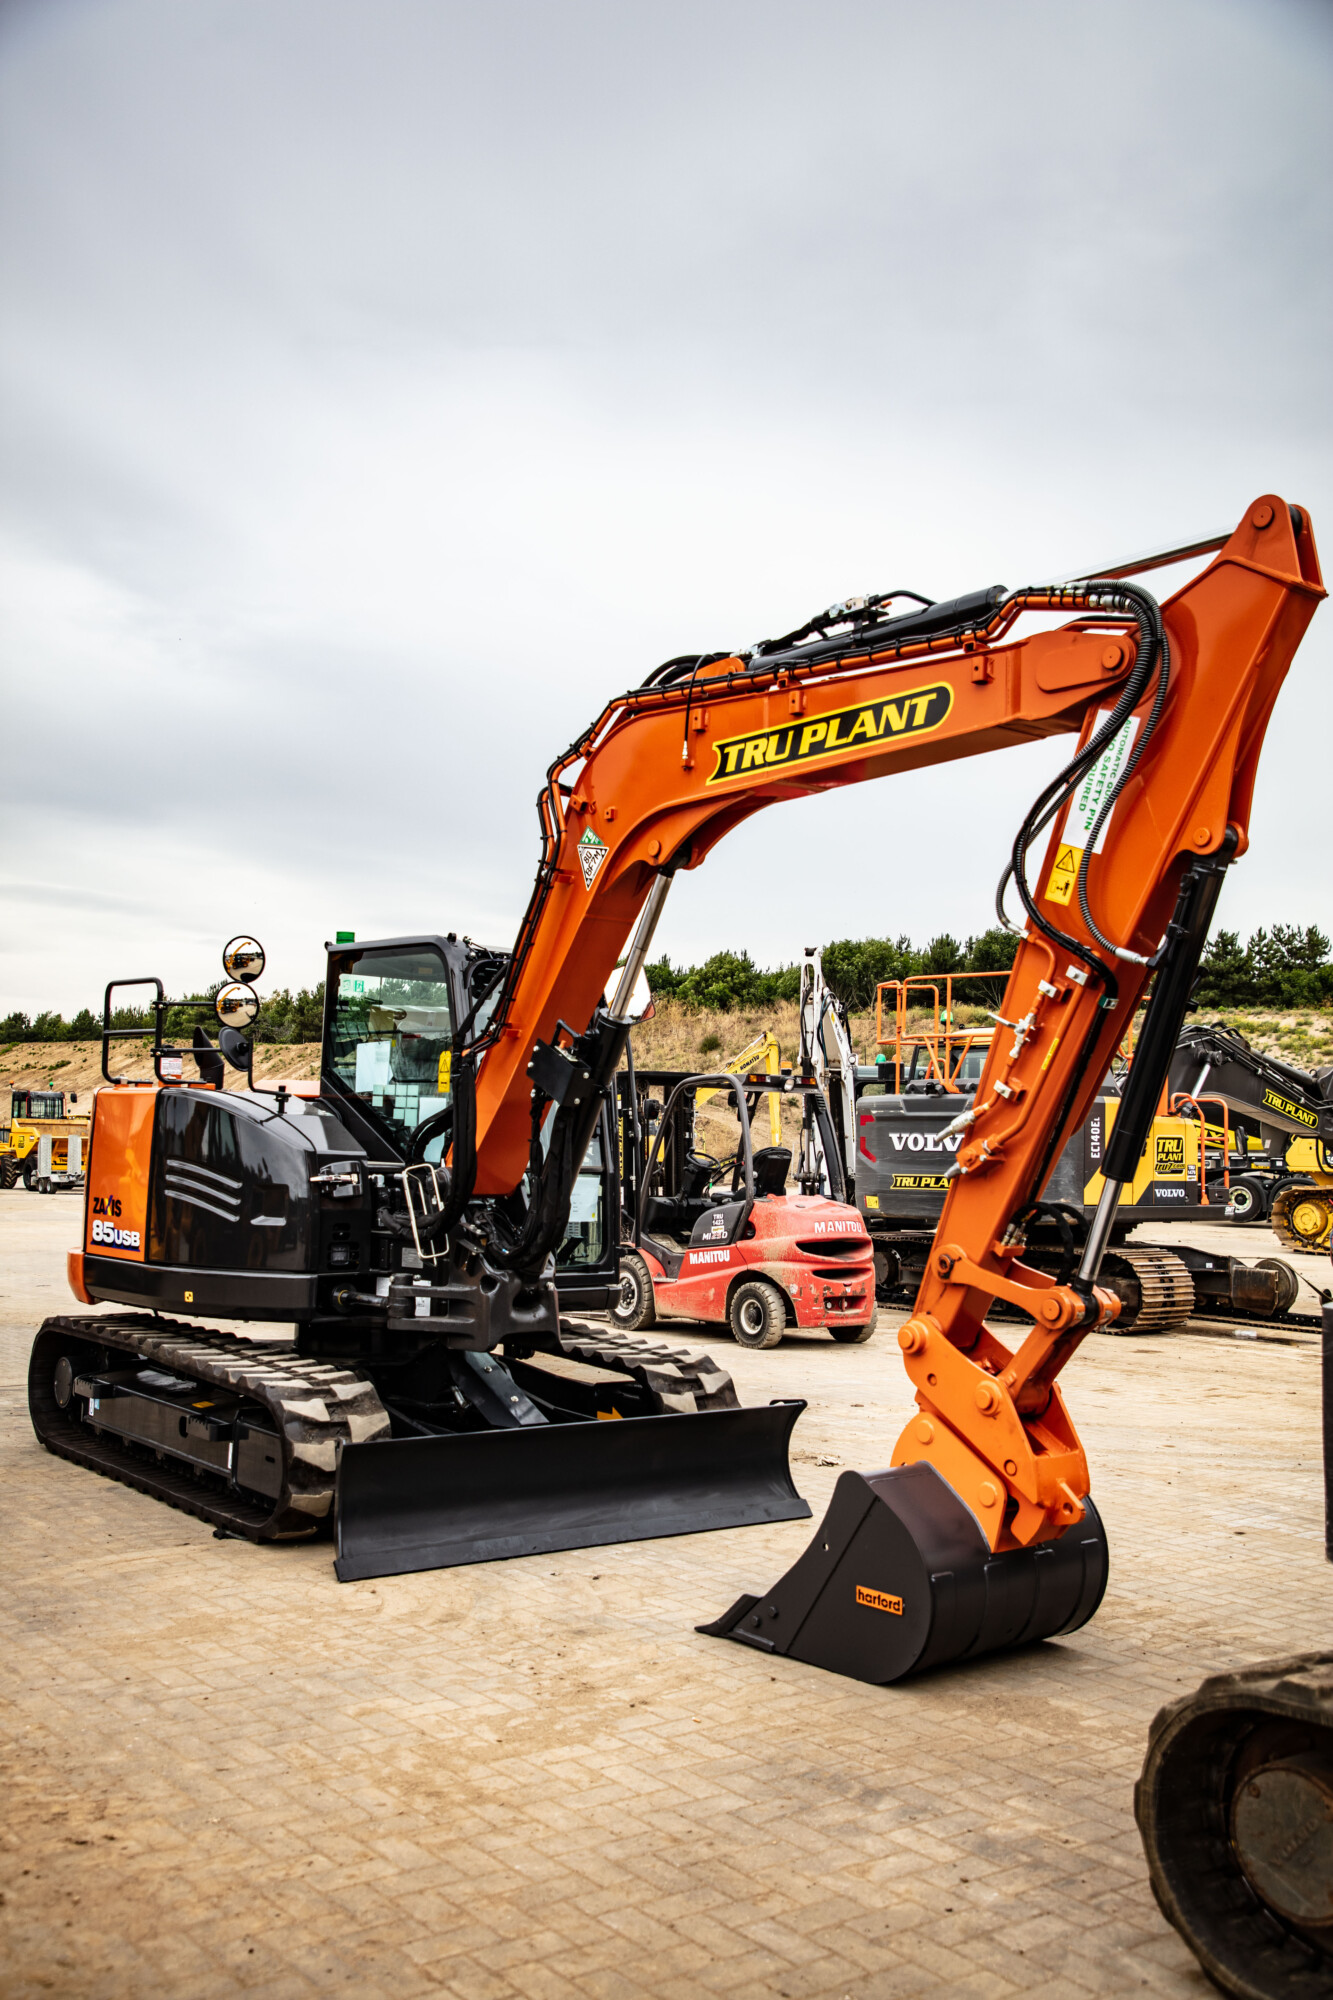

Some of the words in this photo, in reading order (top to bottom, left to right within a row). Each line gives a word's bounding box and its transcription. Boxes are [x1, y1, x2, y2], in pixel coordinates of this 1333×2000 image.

[723, 729, 795, 773] TRU
[797, 692, 938, 756] PLANT
[1109, 719, 1132, 779] AUTOMATIC
[1078, 760, 1098, 812] QUIRED
[1090, 755, 1112, 806] SAFETY
[1083, 808, 1096, 831] PIN
[1266, 1092, 1286, 1111] TRU
[1284, 1102, 1316, 1126] PLANT
[888, 1132, 966, 1152] VOLV
[1157, 1139, 1183, 1153] TRU
[1157, 1152, 1183, 1162] PLANT
[894, 1176, 920, 1187] TRU
[920, 1176, 953, 1188] PLA
[1154, 1188, 1186, 1198] VOLVO
[92, 1194, 122, 1218] ZAXIS
[712, 1212, 724, 1220] TRU
[813, 1220, 863, 1234] MANITOU
[688, 1249, 731, 1265] MANITOU
[857, 1588, 901, 1613] harford
